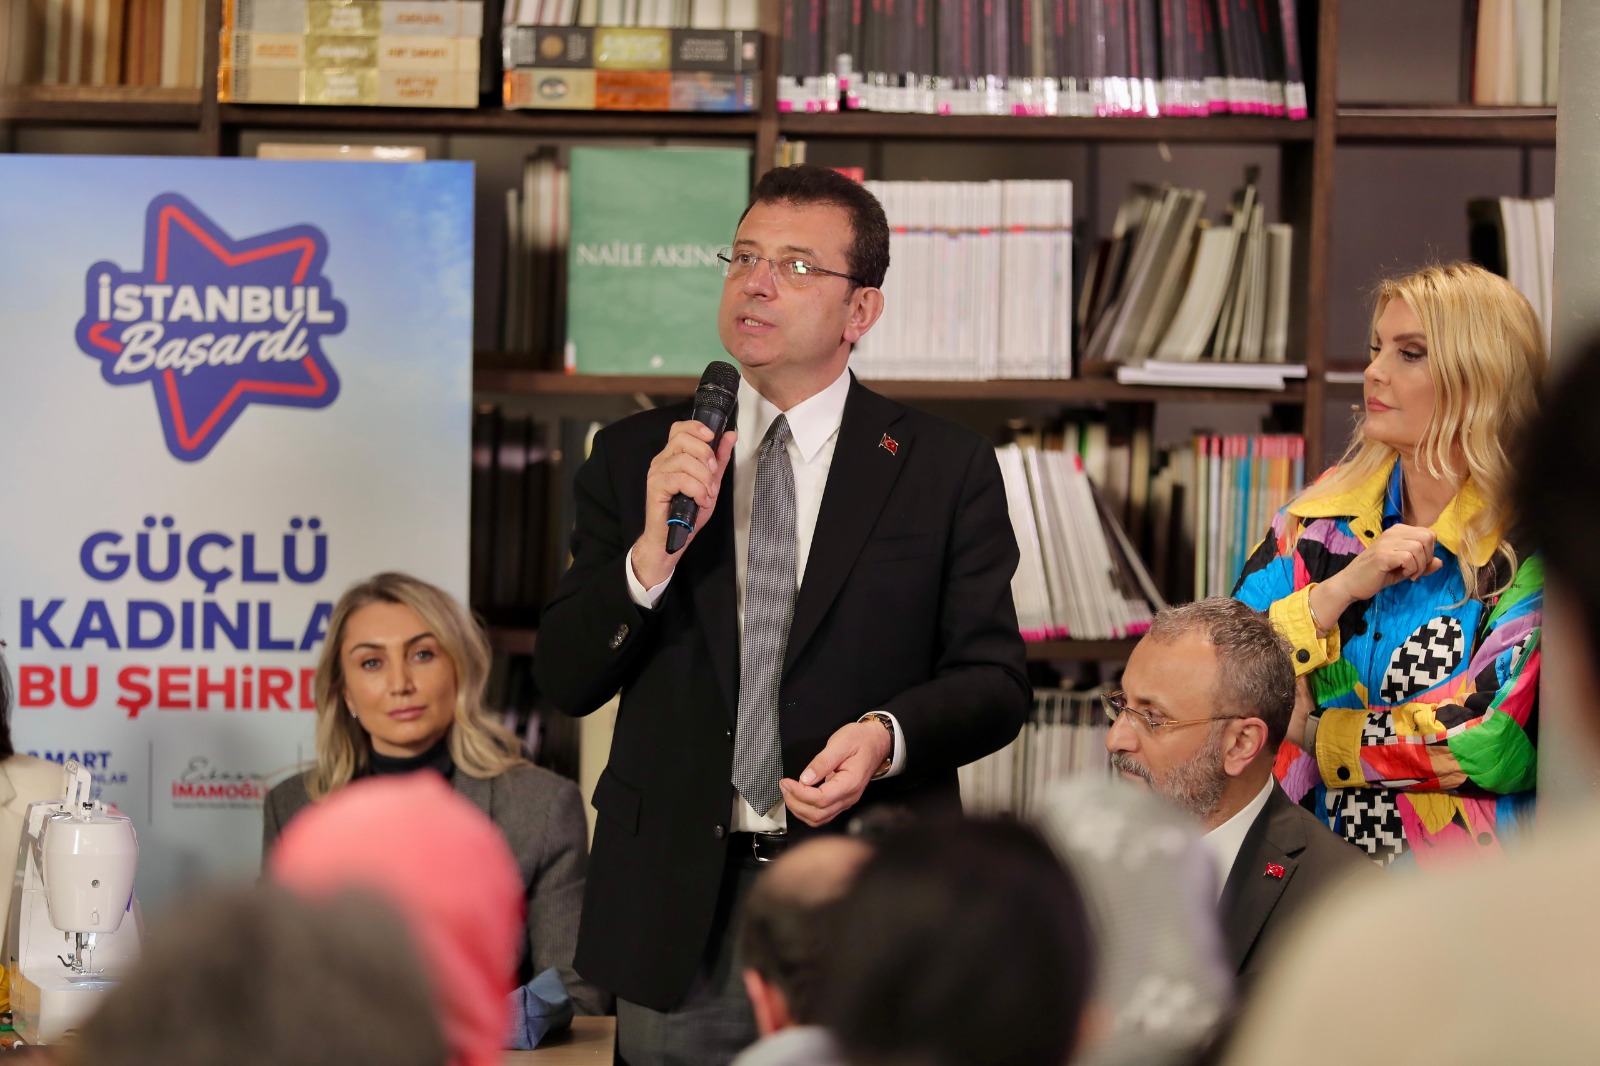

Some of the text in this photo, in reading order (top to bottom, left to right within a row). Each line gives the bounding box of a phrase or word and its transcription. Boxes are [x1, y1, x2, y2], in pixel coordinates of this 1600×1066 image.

[98, 273, 335, 323] İSTANBUL
[112, 309, 310, 377] Başardı
[79, 516, 328, 595] GÜÇLÜ
[19, 598, 335, 651] KADINLA
[18, 664, 318, 720] BU ŞEHİR
